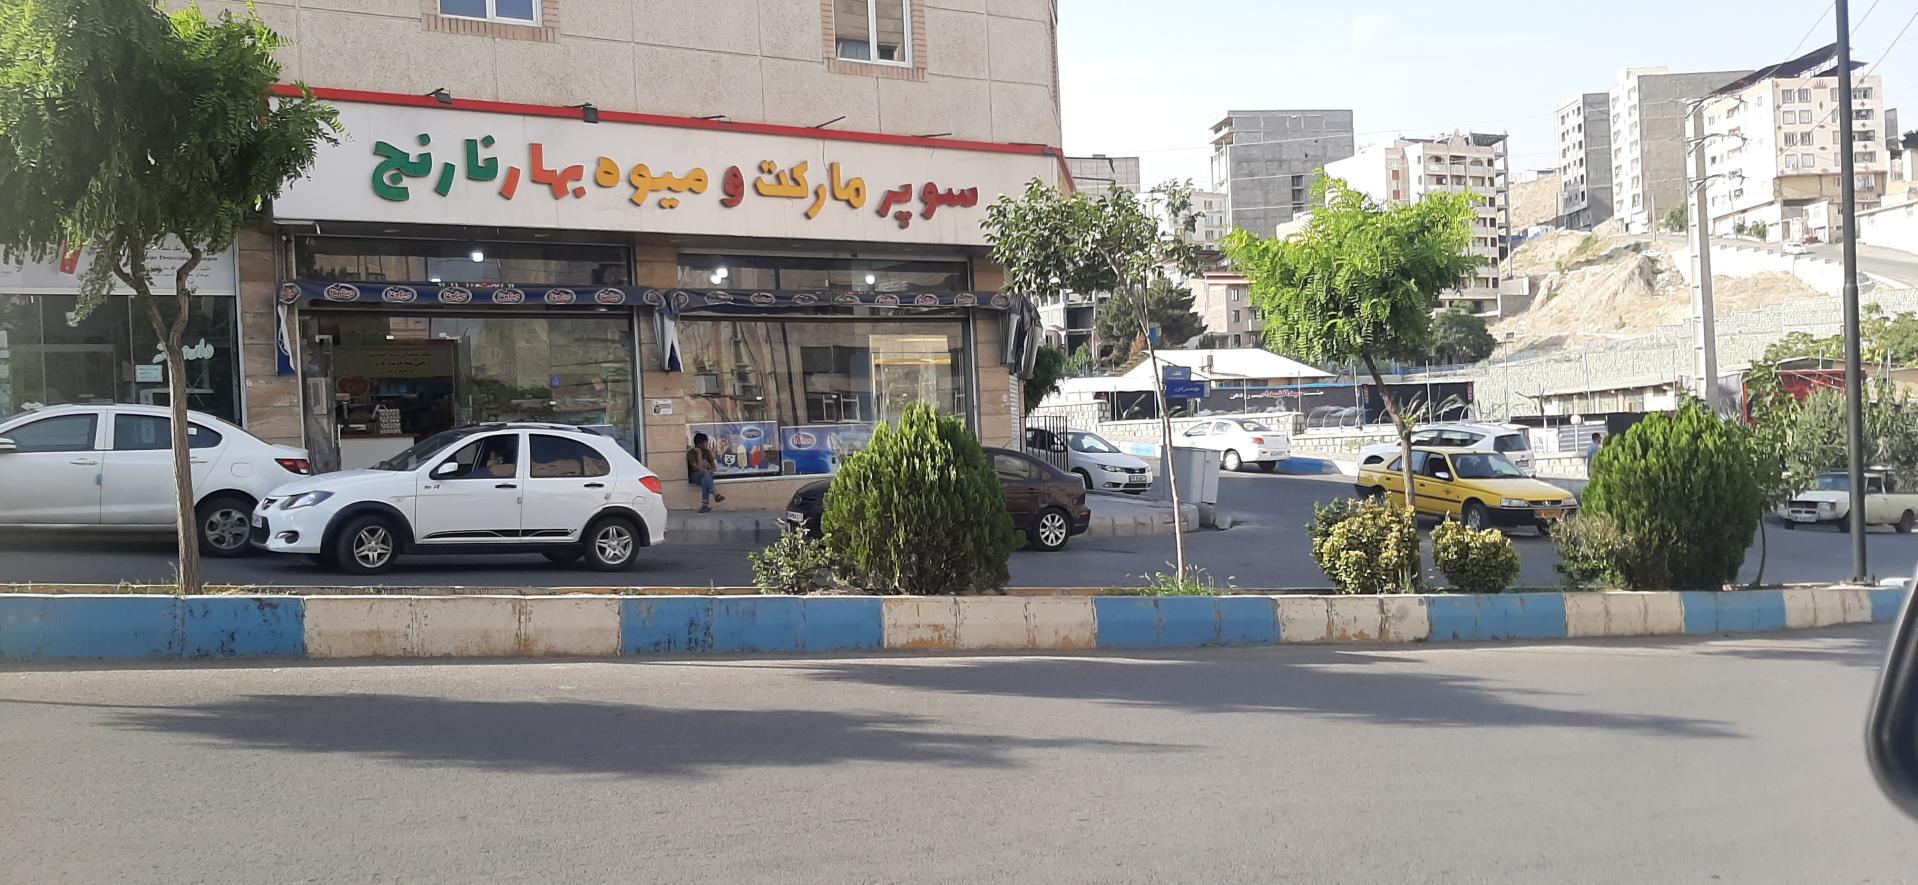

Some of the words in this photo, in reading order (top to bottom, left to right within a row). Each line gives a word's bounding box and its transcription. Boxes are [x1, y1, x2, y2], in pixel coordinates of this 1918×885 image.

[594, 155, 710, 210] میوه
[720, 164, 746, 209] و
[753, 159, 868, 220] مارکت
[876, 180, 979, 229] سوپر
